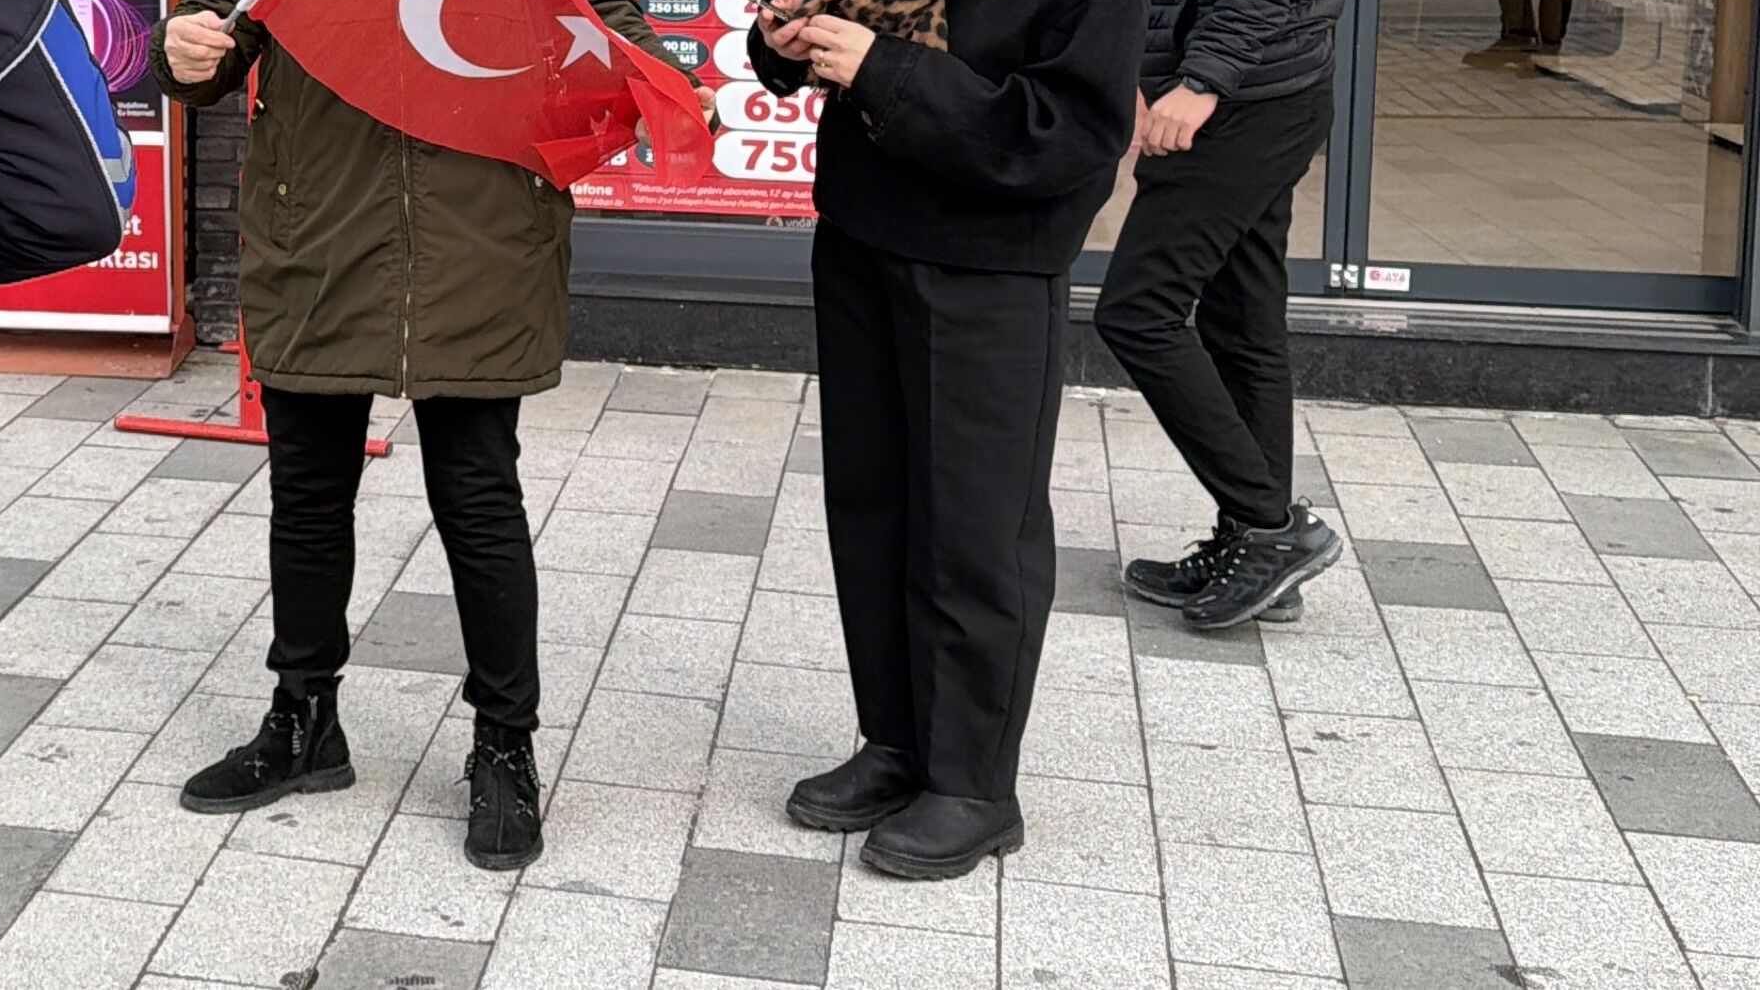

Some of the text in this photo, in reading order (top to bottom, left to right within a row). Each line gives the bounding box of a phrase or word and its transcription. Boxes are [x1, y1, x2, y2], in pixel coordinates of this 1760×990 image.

[648, 3, 700, 13] 250 SMS
[680, 41, 698, 51] DK
[679, 54, 698, 64] MS
[744, 90, 826, 123] 650
[741, 139, 817, 174] 750
[87, 250, 158, 269] ktası
